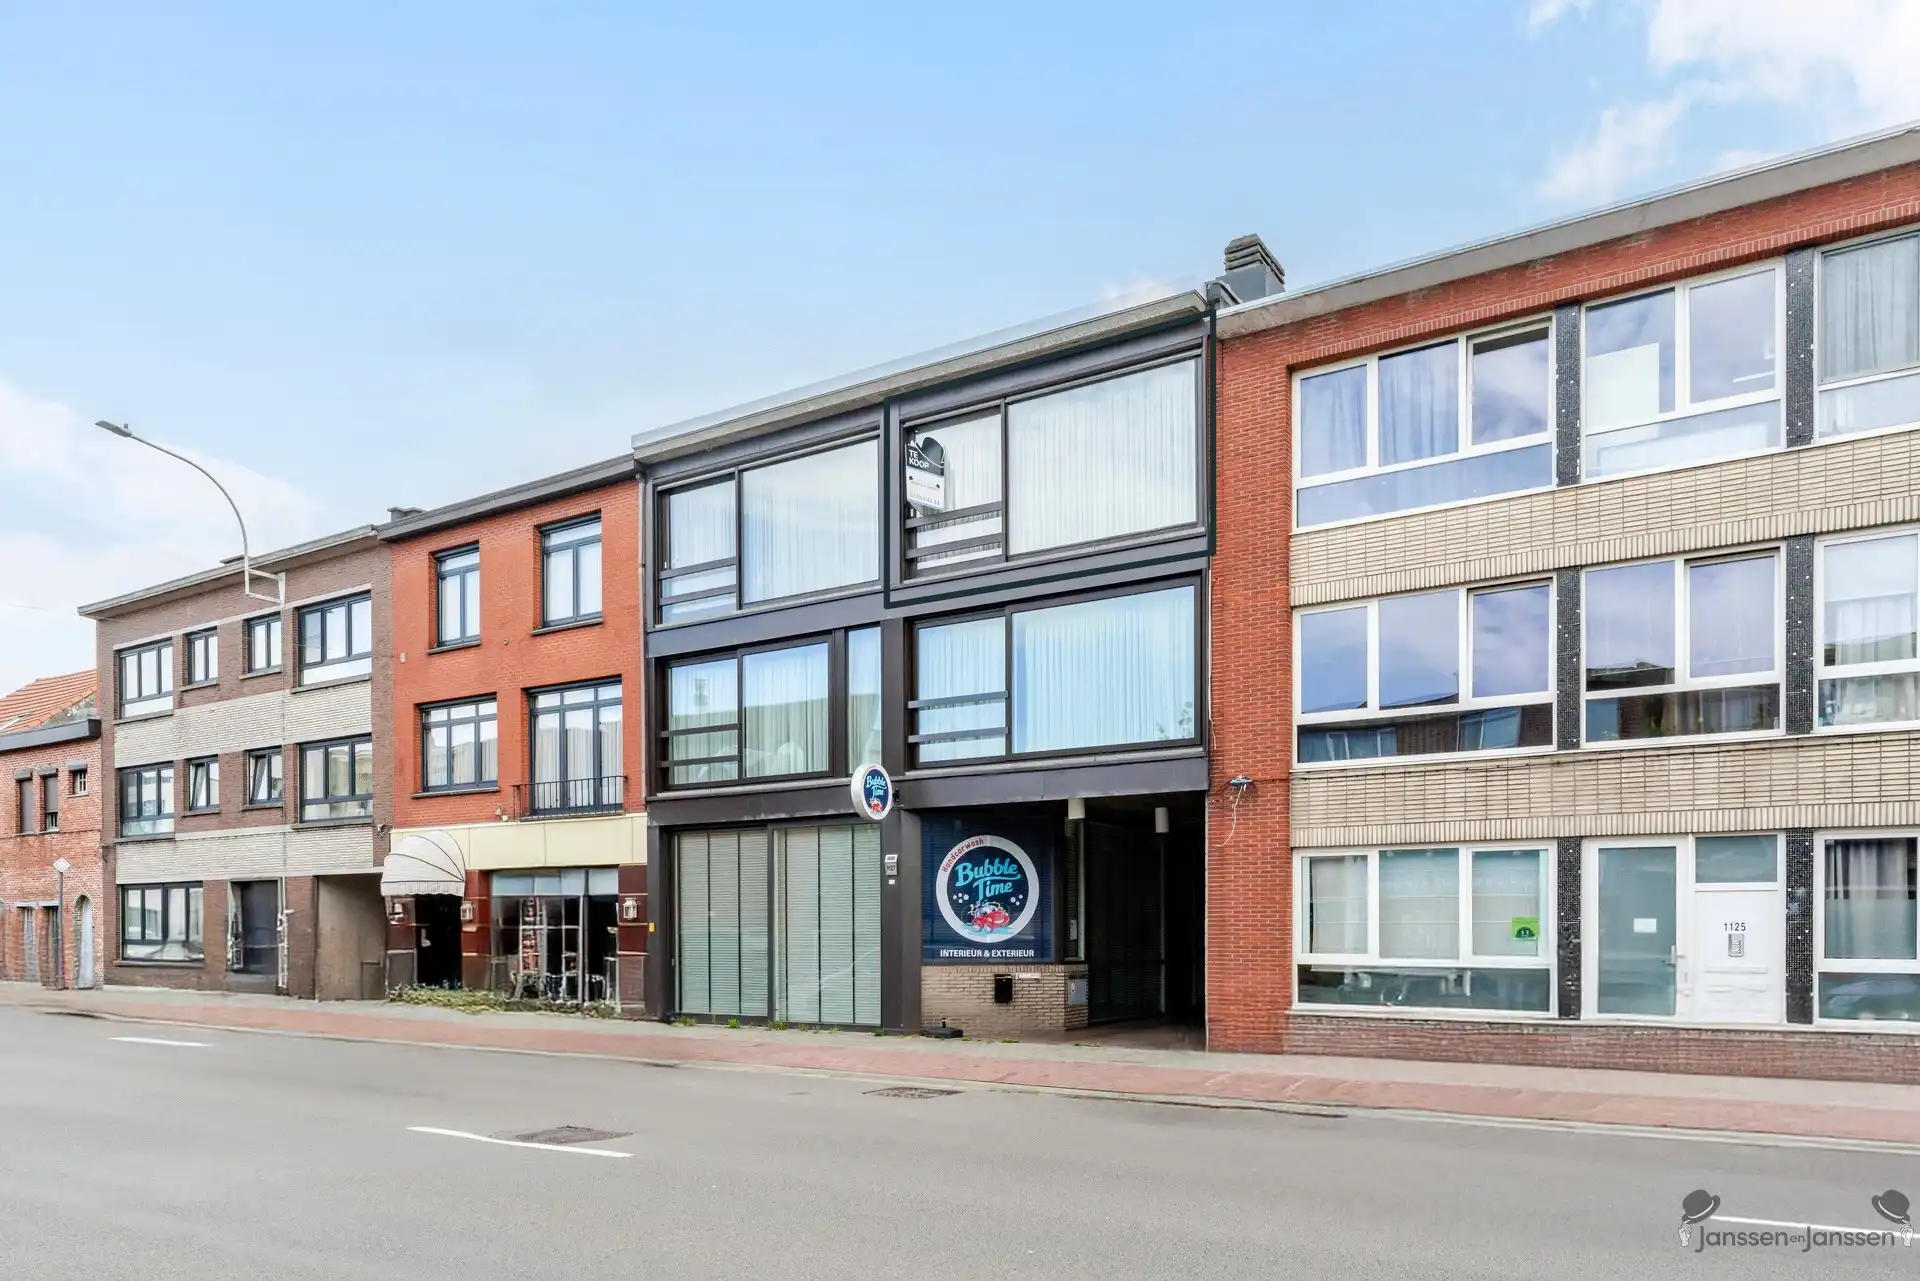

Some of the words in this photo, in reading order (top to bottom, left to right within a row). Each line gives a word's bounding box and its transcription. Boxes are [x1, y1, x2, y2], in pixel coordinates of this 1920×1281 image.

[909, 450, 918, 459] TE
[909, 458, 929, 469] KOOP
[866, 775, 886, 788] Bubble
[871, 785, 887, 799] Time
[941, 837, 985, 873] Handcarwash
[955, 857, 1018, 887] Bubble
[972, 875, 1021, 901] Time
[1724, 922, 1746, 931] 1125
[940, 949, 982, 957] INTERIEUR
[983, 949, 990, 957] &
[991, 949, 1035, 958] EXTERIEUR
